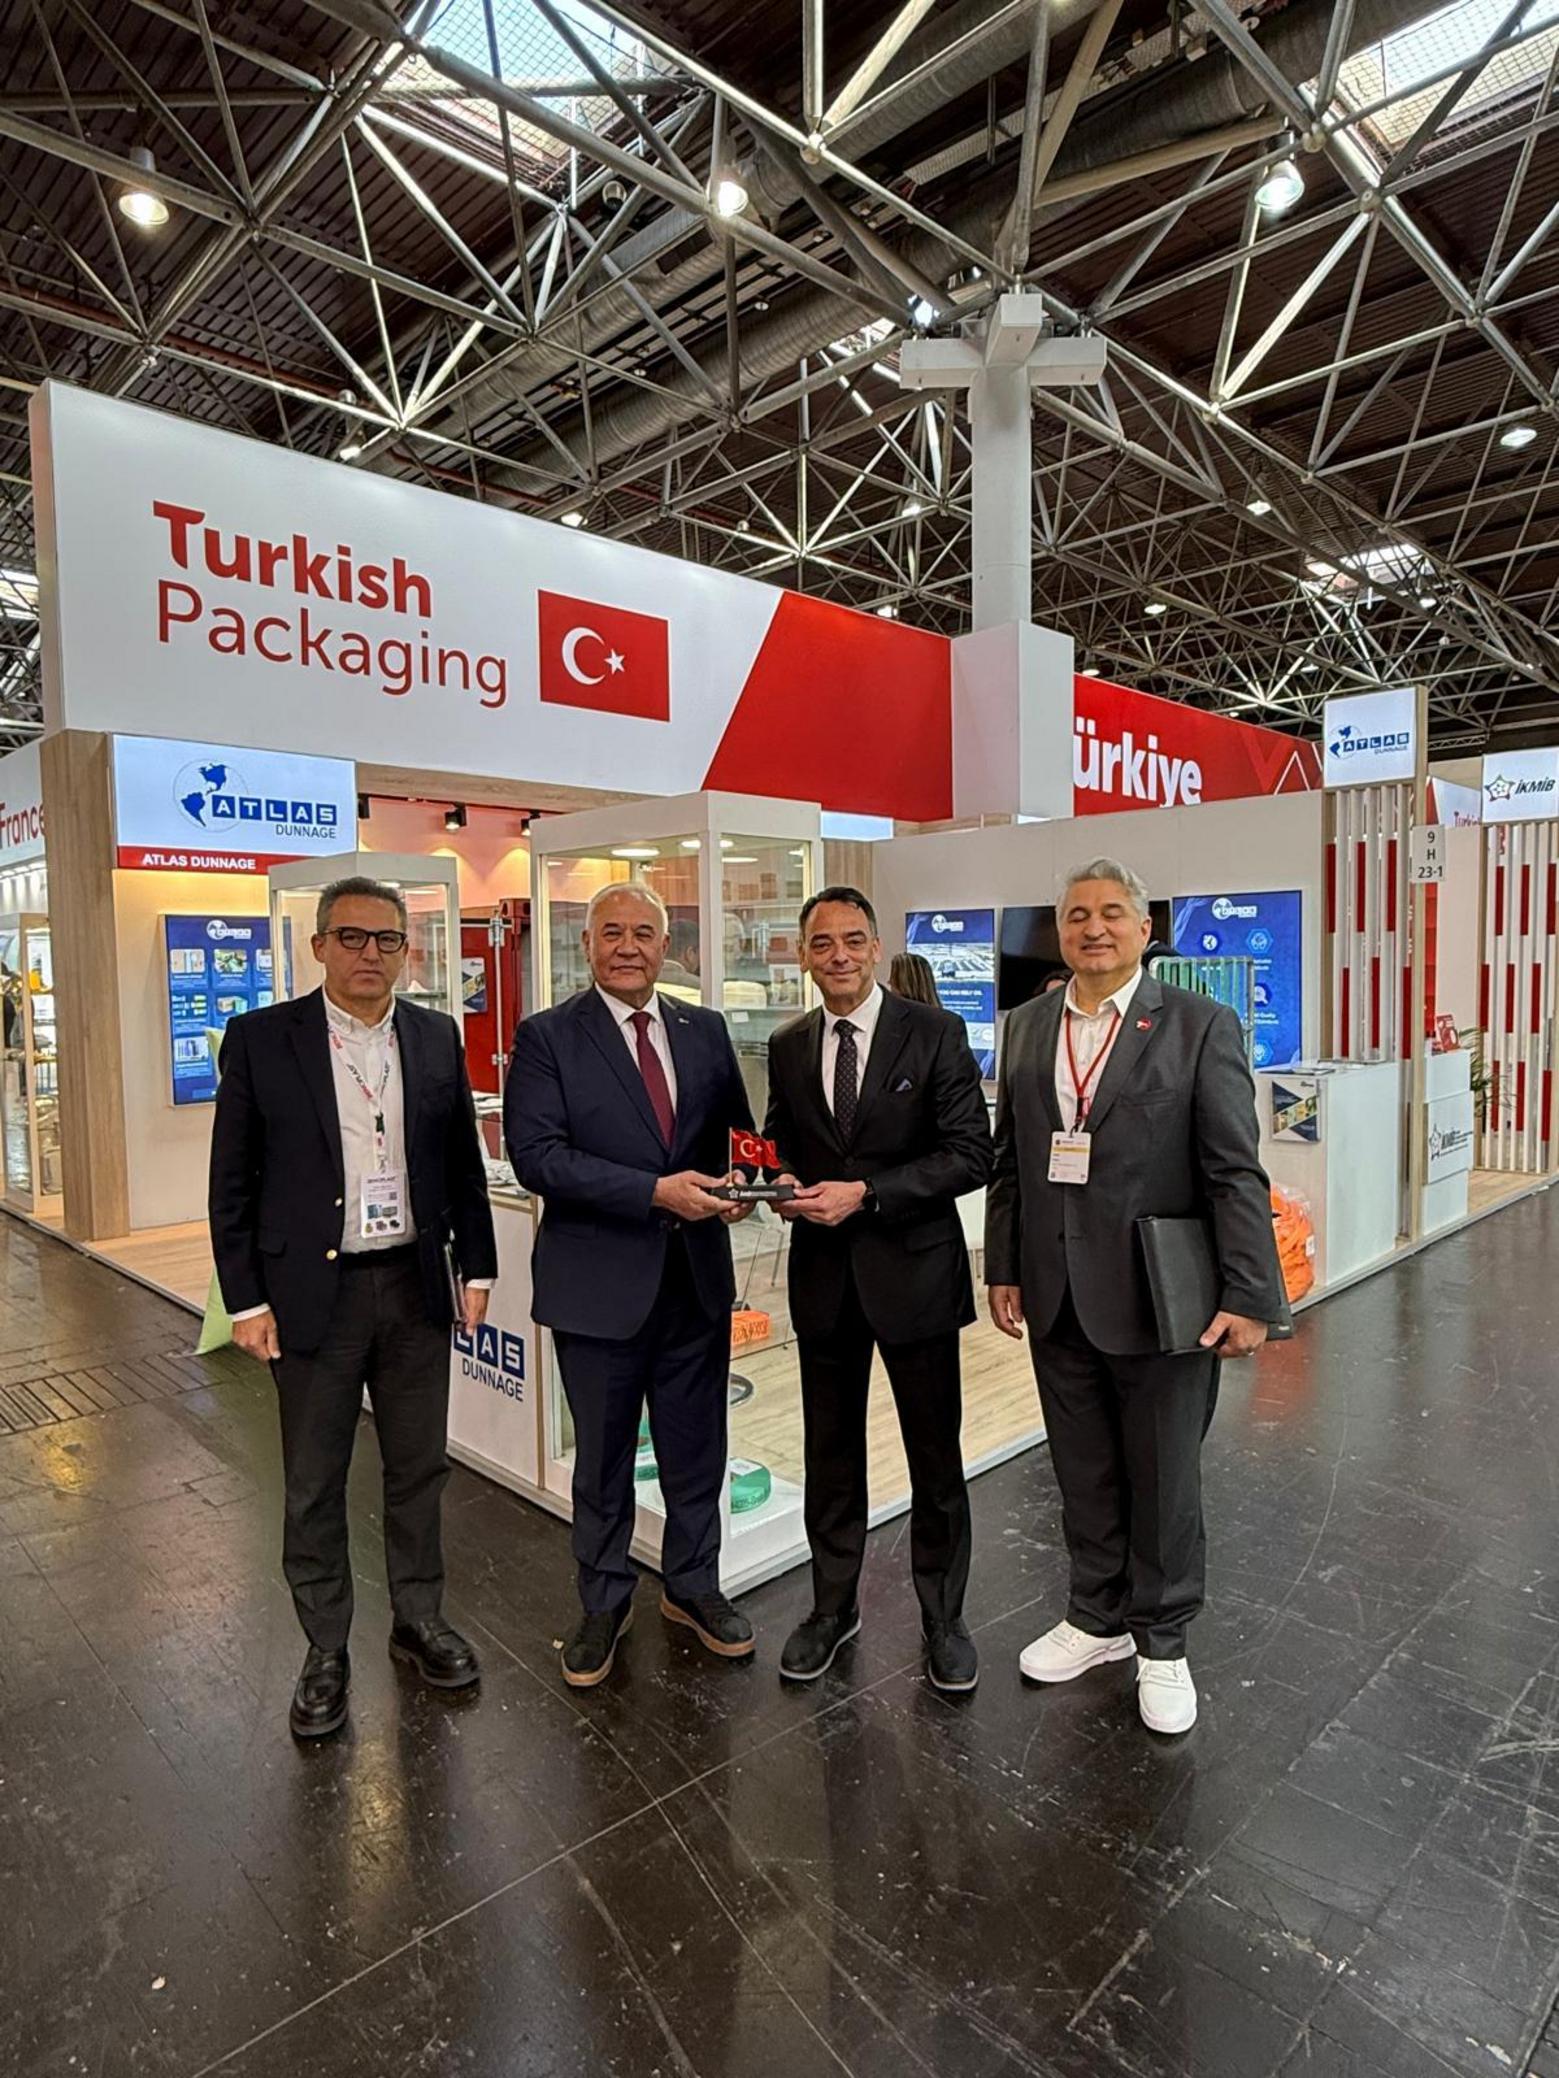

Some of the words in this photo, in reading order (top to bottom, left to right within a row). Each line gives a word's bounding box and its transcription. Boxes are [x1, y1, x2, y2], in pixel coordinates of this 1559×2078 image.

[153, 500, 432, 619] Turkish
[157, 579, 508, 709] Packaging
[1073, 716, 1202, 808] ürkiye
[1514, 776, 1556, 795] İKMİB
[213, 797, 337, 824] ATLAS
[275, 823, 337, 839] DUNNAGE
[1427, 831, 1435, 843] 9
[142, 852, 188, 867] ATLAS
[190, 855, 256, 870] DUNNAGE
[1427, 848, 1436, 860] H
[1417, 865, 1443, 879] 23-1
[455, 1327, 523, 1375] LAS
[462, 1357, 524, 1402] DUNNAGE
